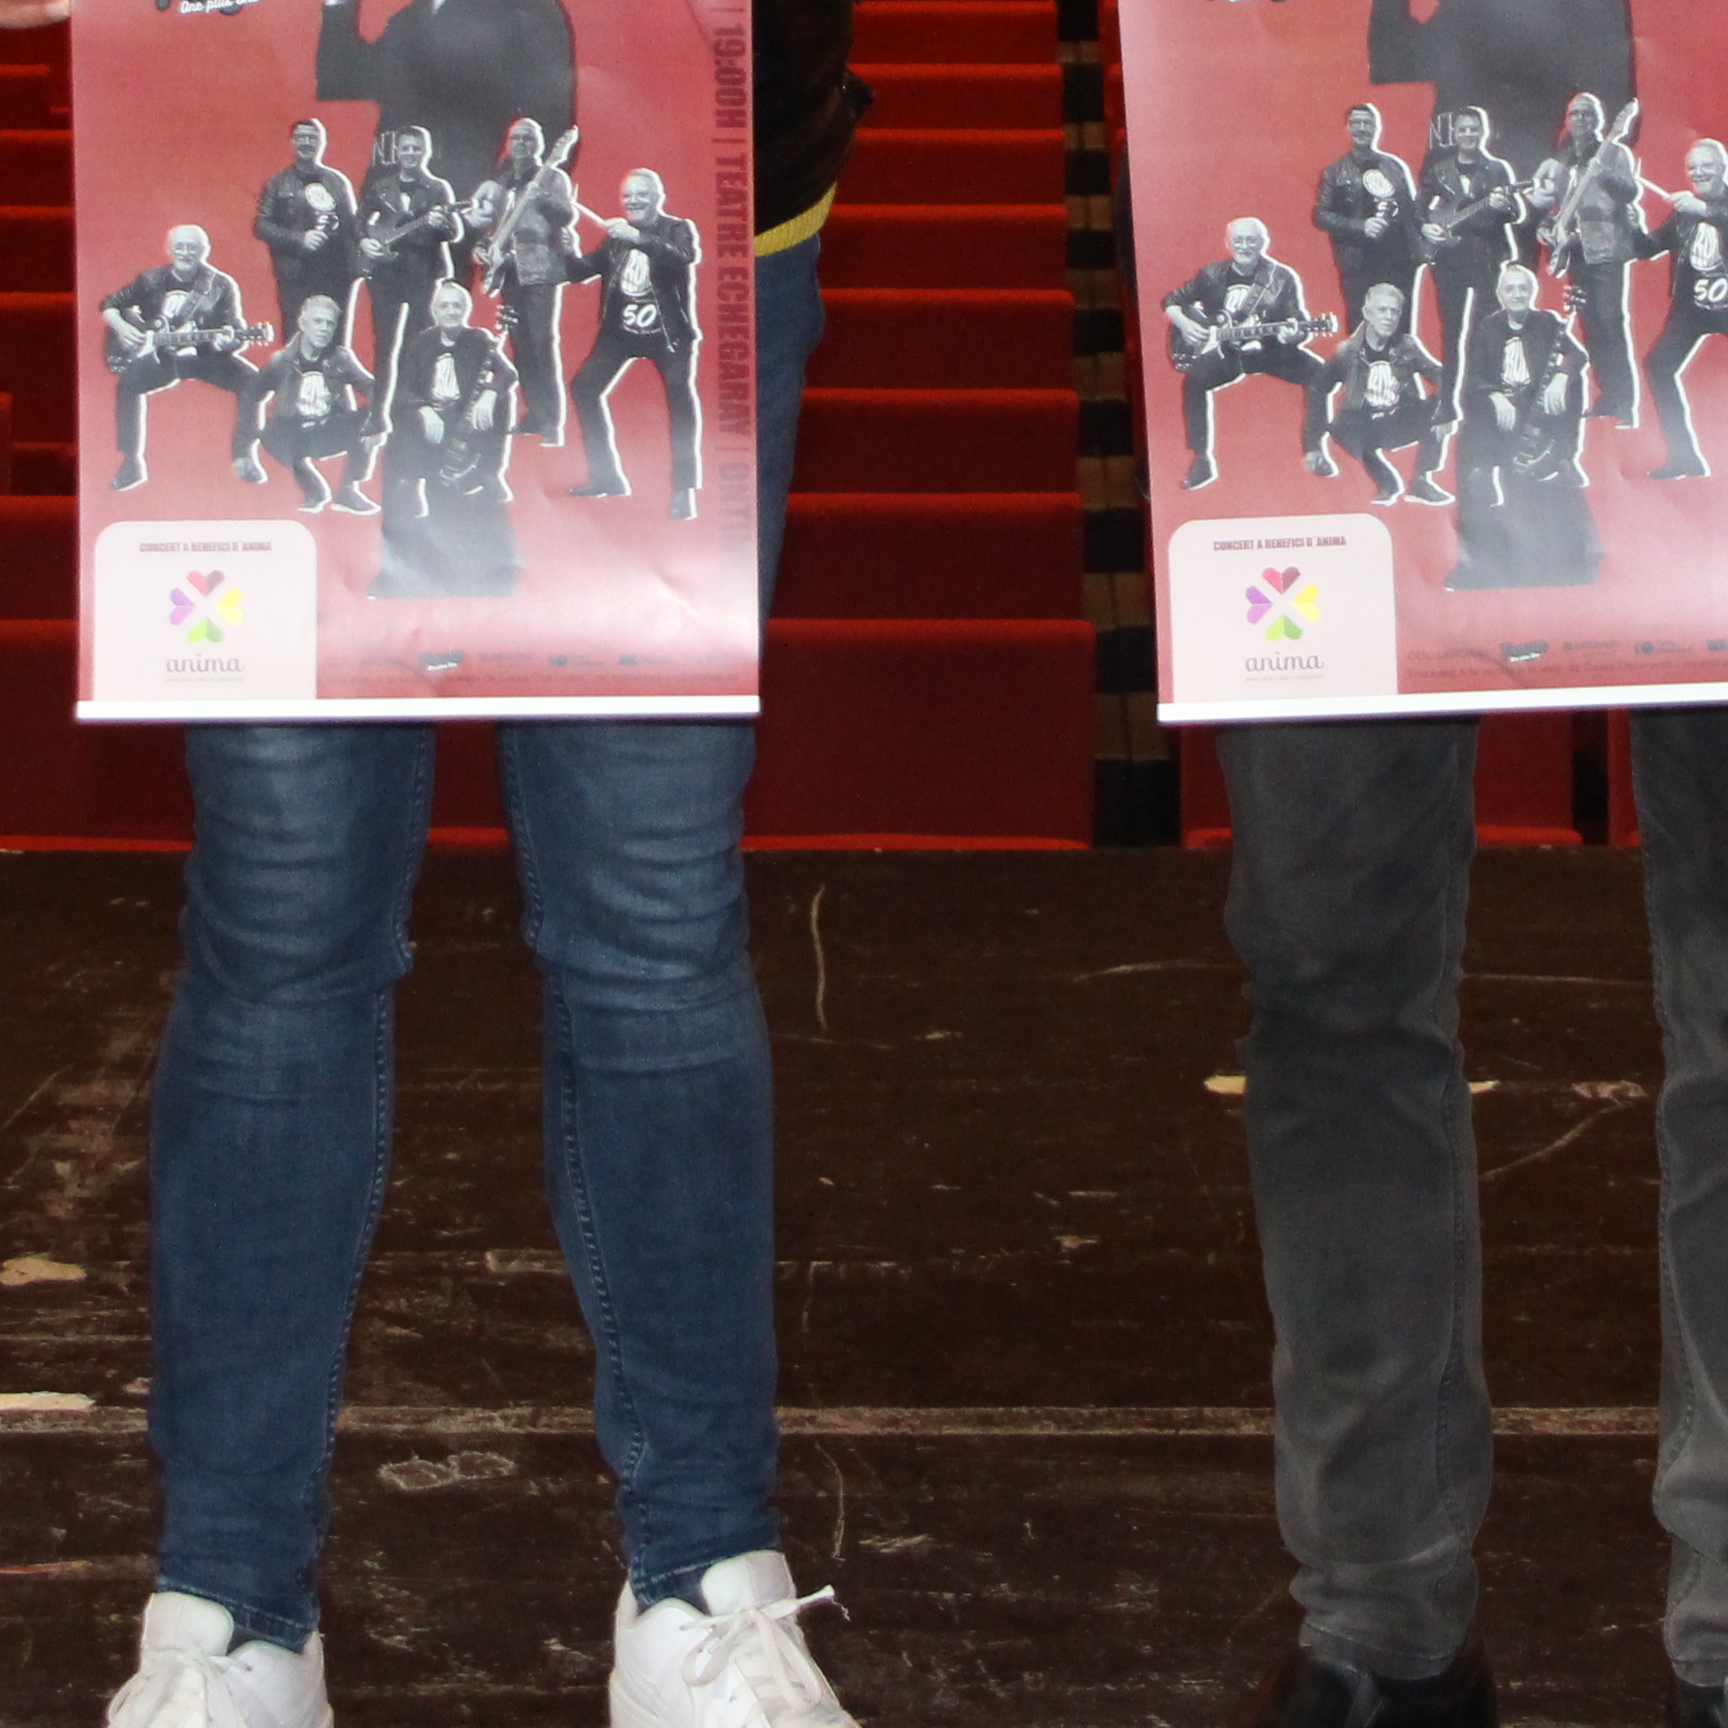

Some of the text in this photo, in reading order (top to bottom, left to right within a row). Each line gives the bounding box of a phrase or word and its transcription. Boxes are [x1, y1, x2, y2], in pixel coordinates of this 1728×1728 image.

[1693, 278, 1728, 302] 50
[623, 303, 657, 328] 50
[166, 653, 244, 673] anima
[1245, 651, 1324, 672] anima
